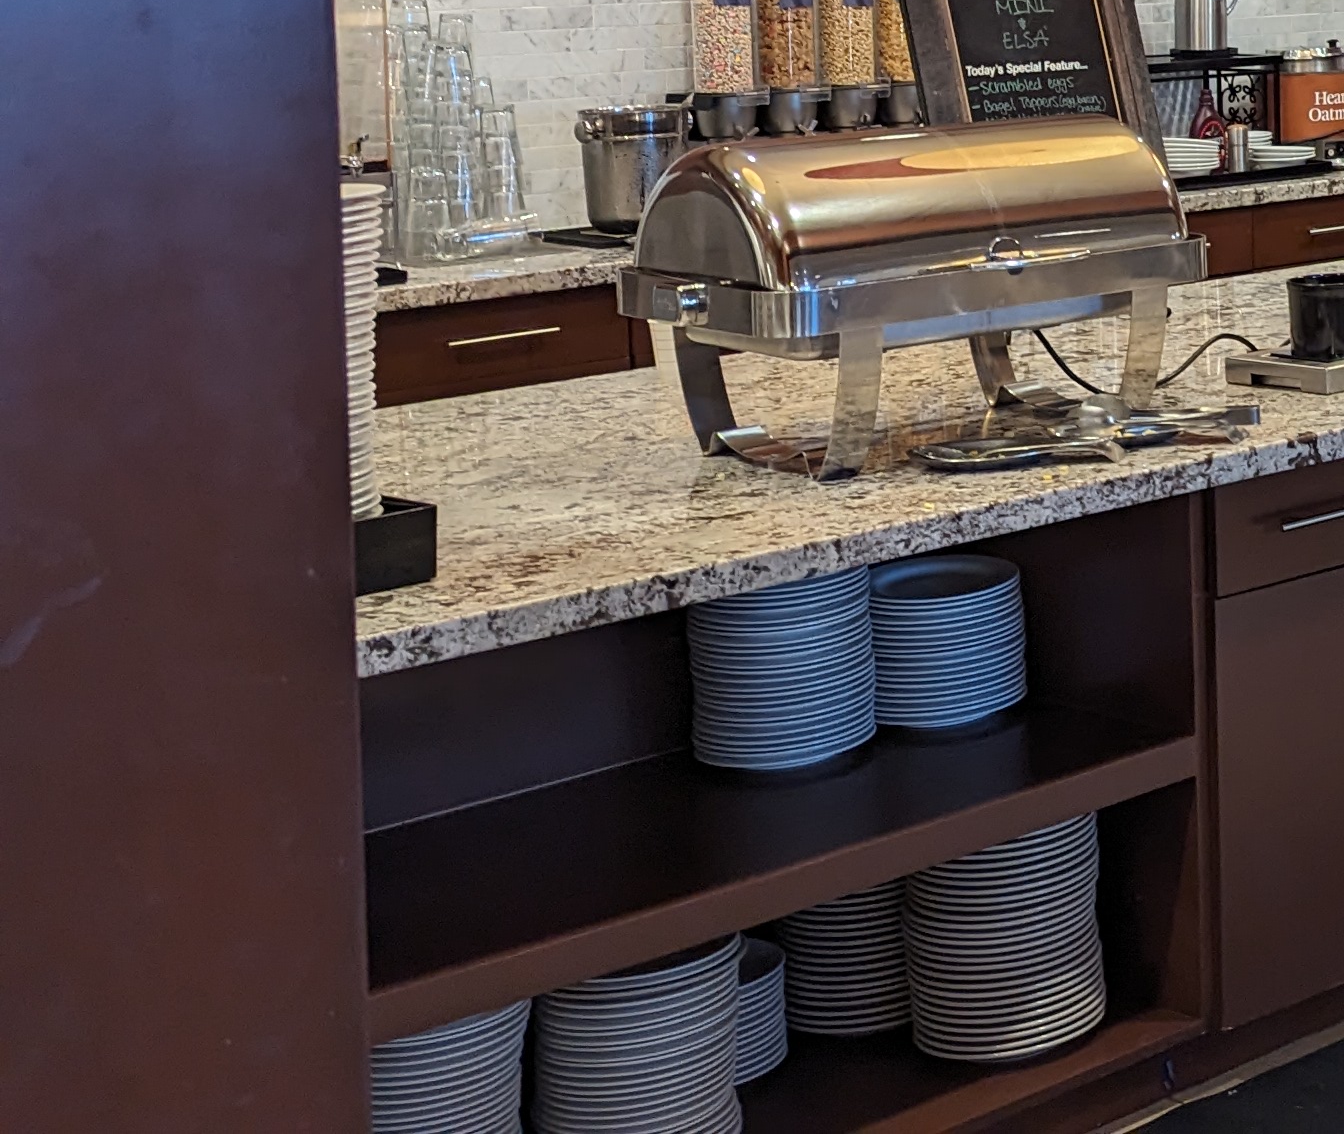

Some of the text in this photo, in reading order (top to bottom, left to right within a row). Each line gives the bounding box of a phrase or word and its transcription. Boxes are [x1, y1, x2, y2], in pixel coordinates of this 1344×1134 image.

[1002, 29, 1050, 50] ELSA
[965, 64, 1005, 79] Today's
[1006, 61, 1042, 77] Special
[1047, 76, 1075, 94] eggs
